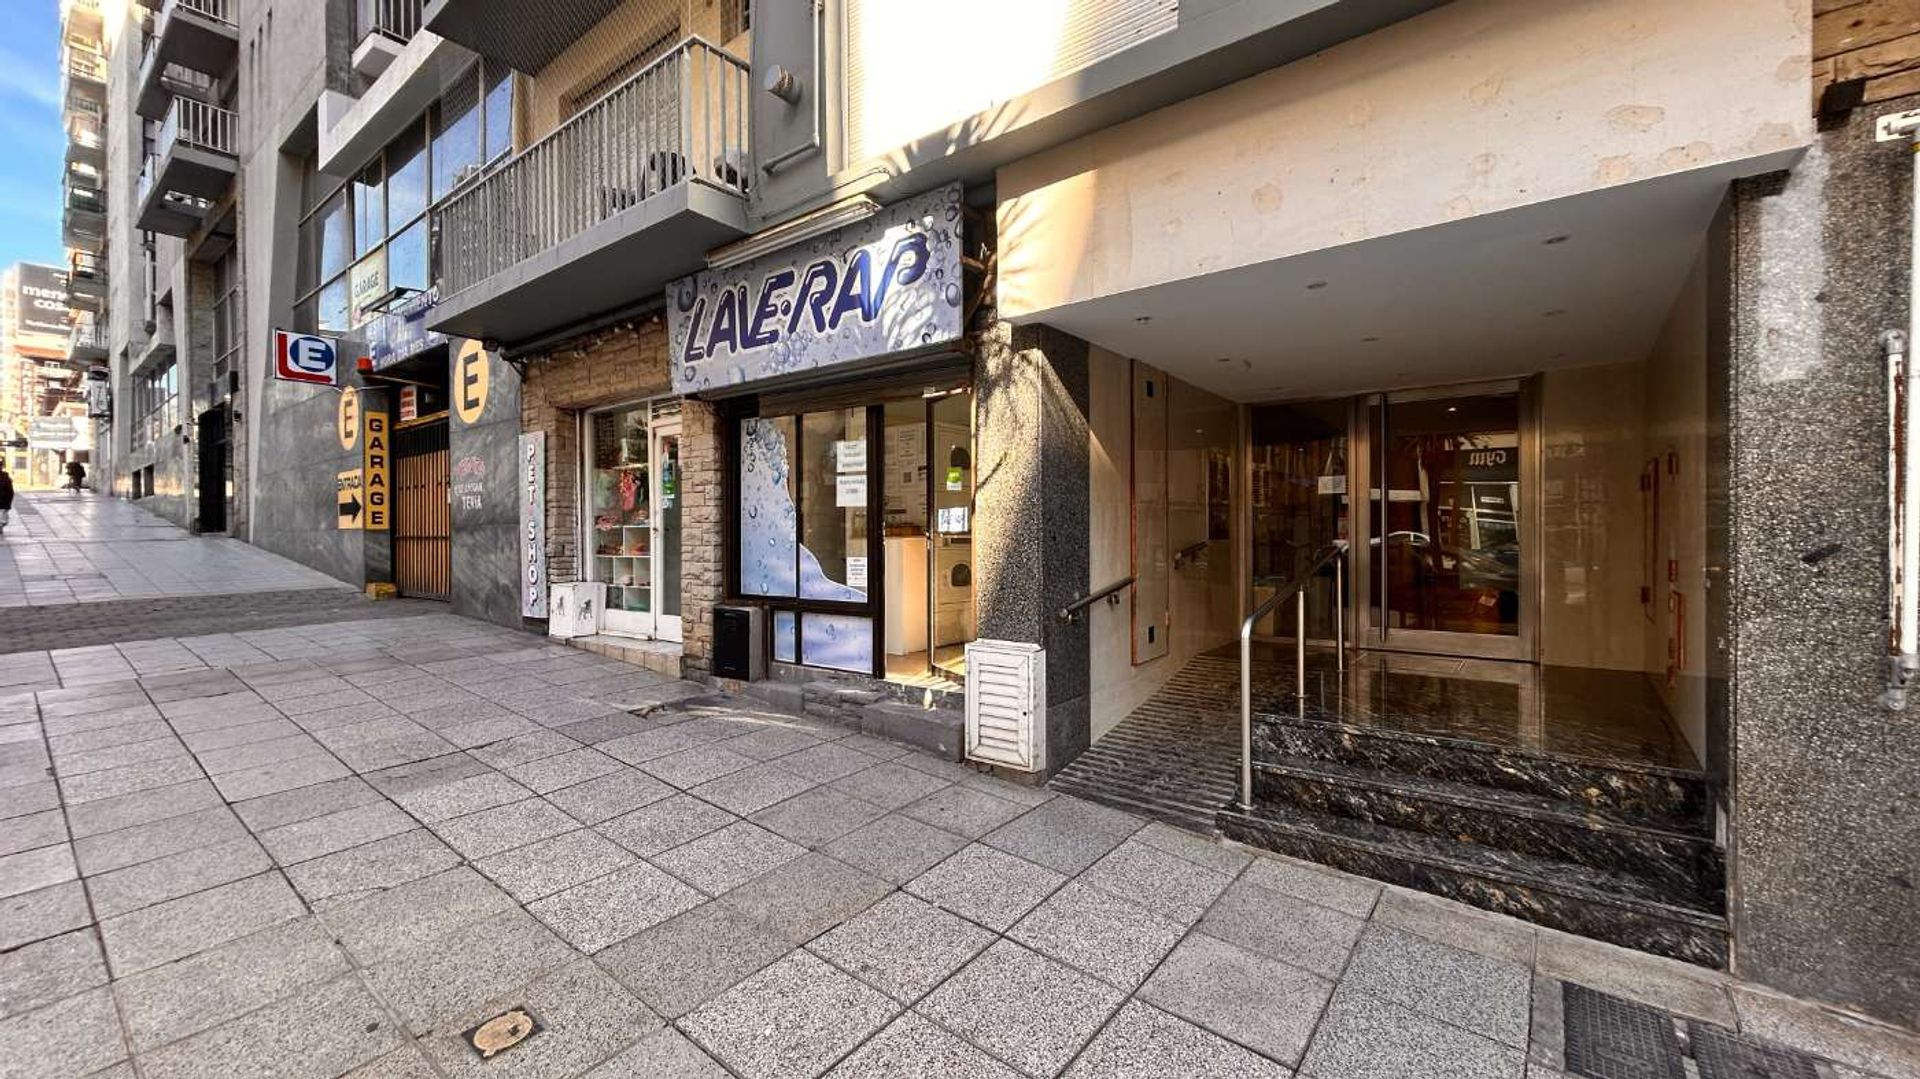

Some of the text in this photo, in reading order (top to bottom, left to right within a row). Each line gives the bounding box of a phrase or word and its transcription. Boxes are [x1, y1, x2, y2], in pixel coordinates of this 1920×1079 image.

[353, 272, 380, 298] GARAGE
[464, 352, 480, 411] E
[344, 399, 353, 439] E
[369, 418, 385, 525] GARAGE
[526, 443, 540, 606] PET SHOP
